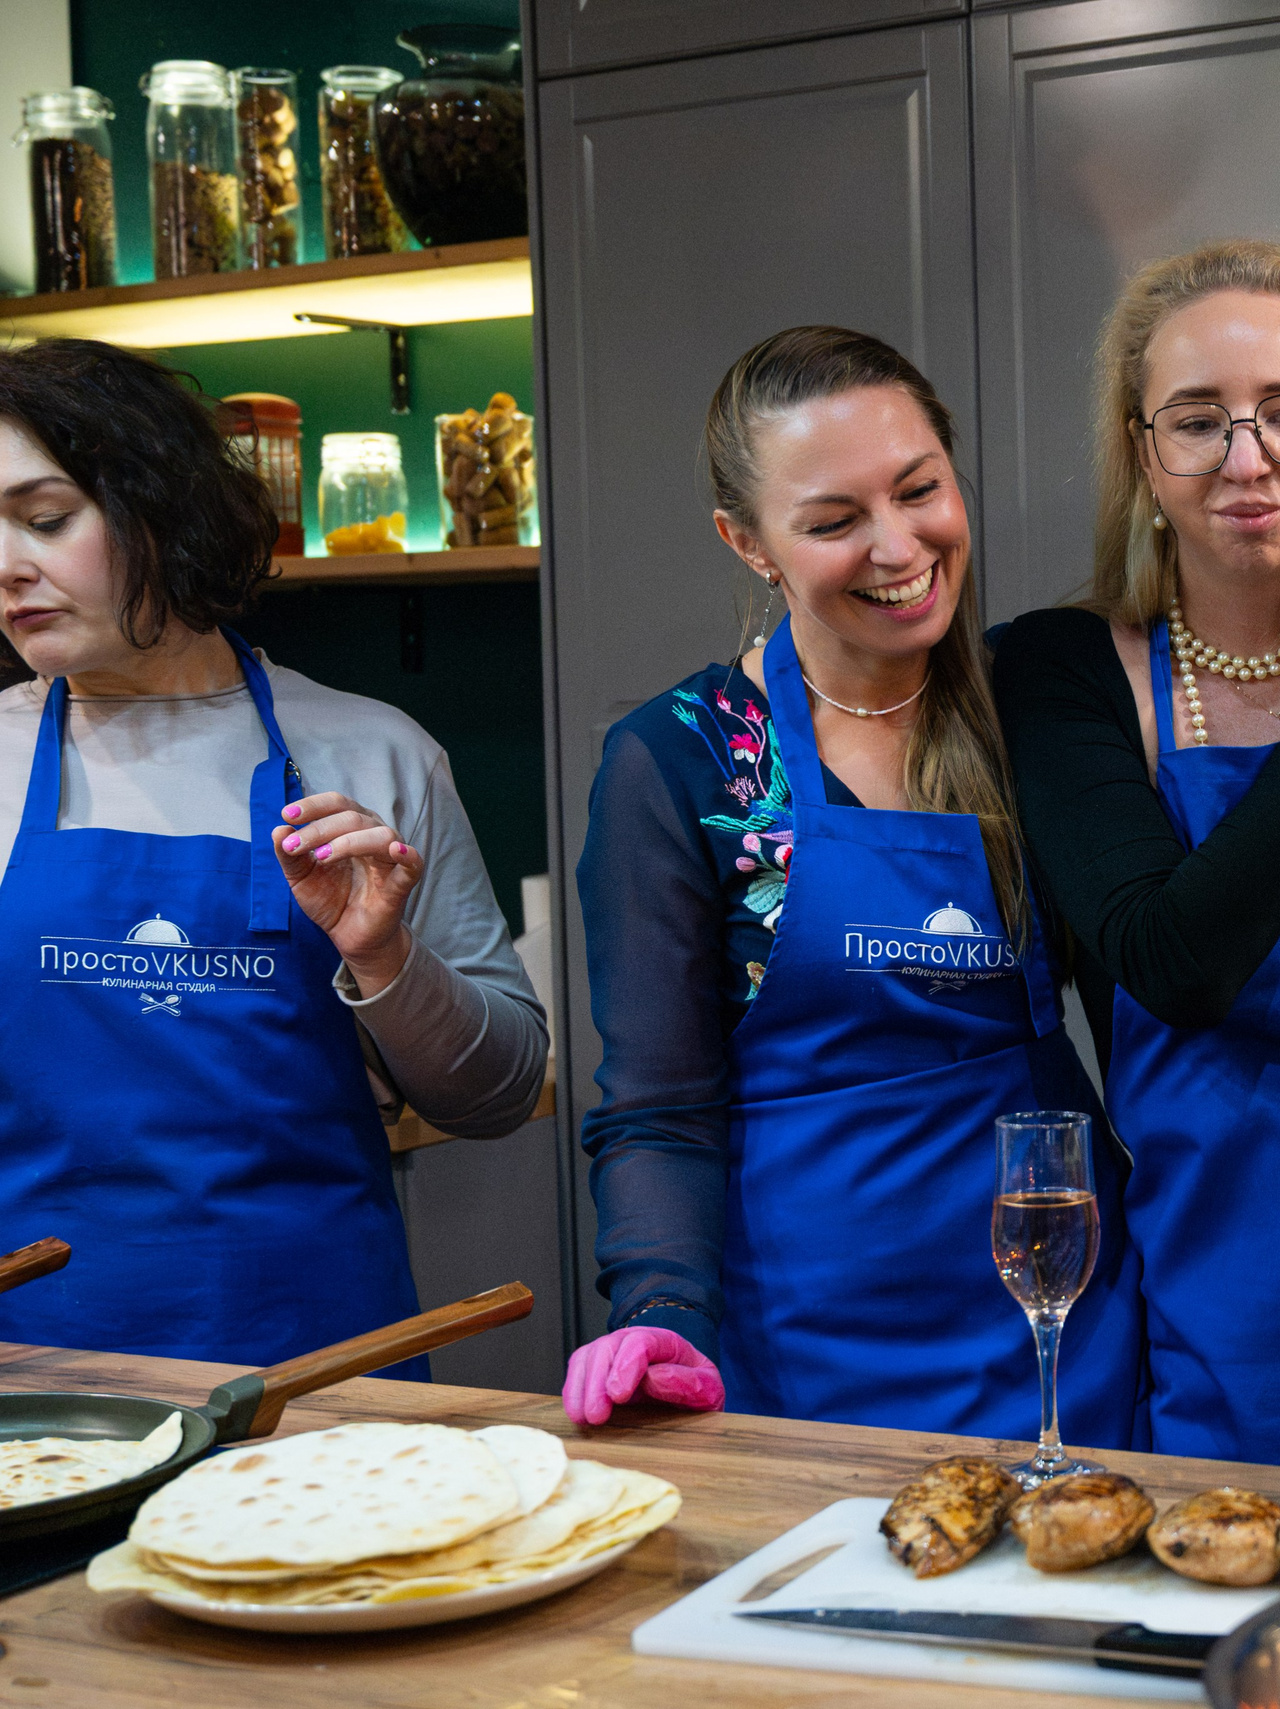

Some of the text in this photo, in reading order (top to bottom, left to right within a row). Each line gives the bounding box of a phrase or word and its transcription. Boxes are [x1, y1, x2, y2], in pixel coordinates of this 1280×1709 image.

[40, 944, 275, 978] ПростоVKUSNO
[845, 932, 1017, 968] ПростоVKUS
[102, 977, 216, 993] КУЛИНАРНАЯ СТУДИЯ
[902, 965, 965, 981] КУЛИНАРНАЯ
